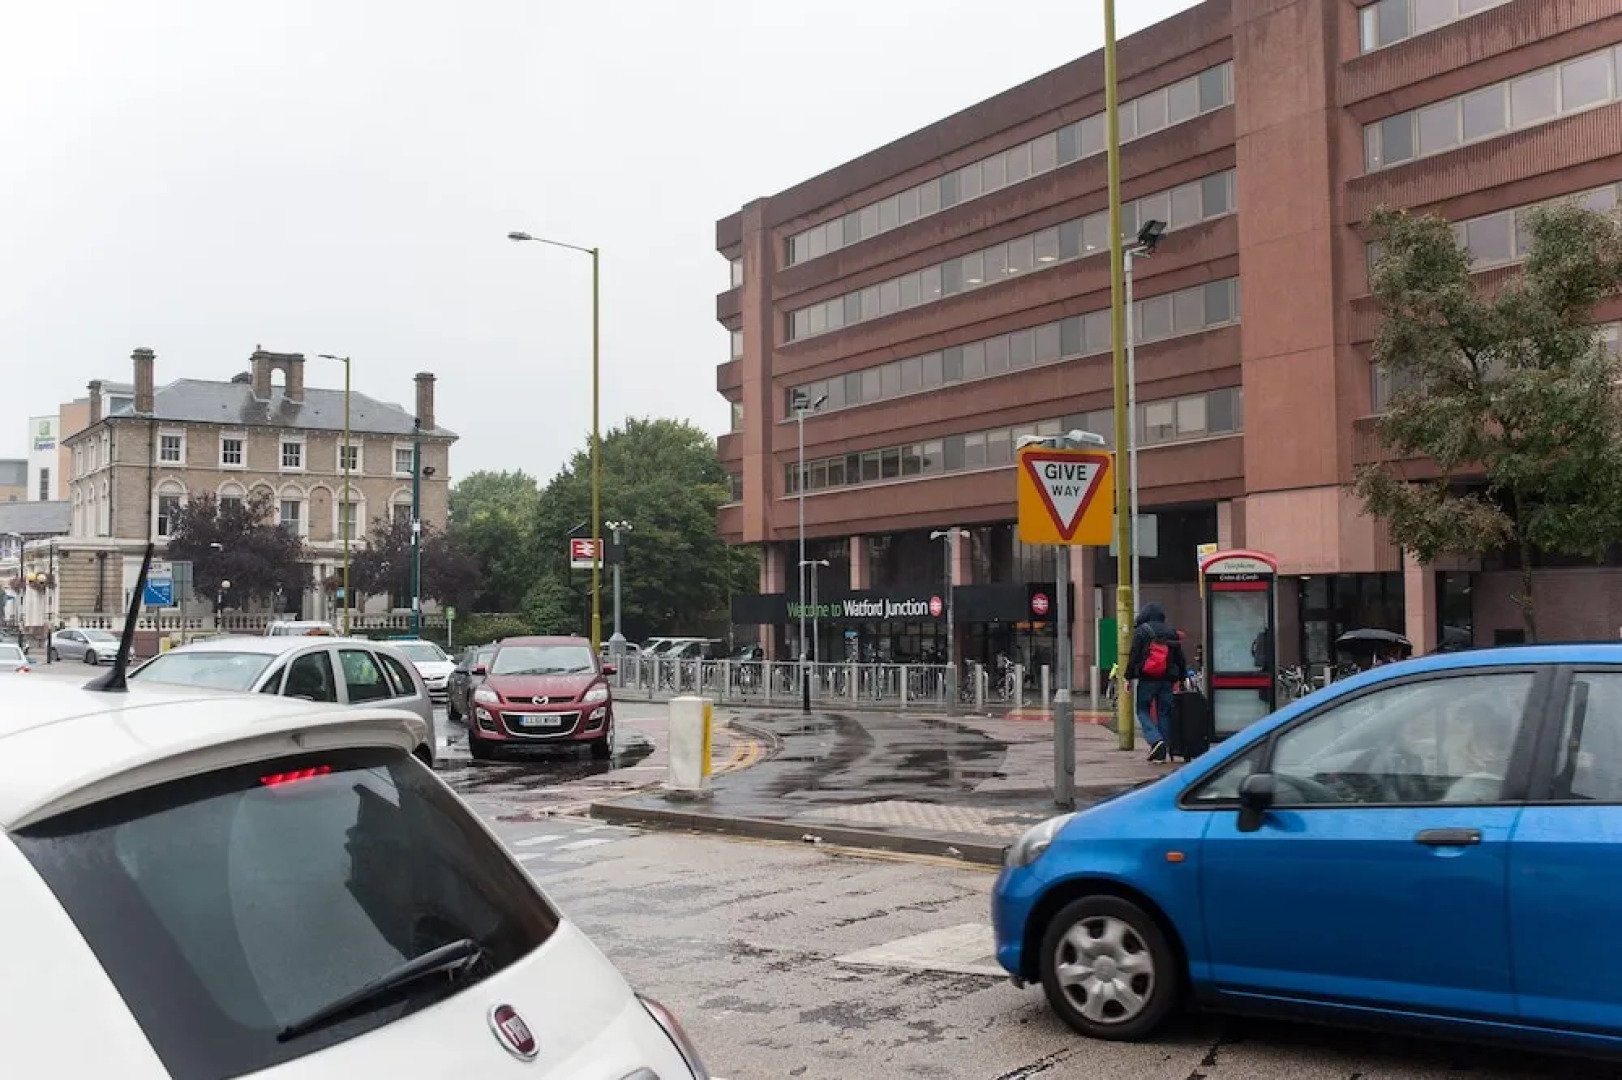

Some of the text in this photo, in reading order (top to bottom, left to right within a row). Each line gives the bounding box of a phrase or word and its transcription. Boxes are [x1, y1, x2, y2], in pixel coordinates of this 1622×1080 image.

[1045, 463, 1087, 480] GIVE
[1052, 485, 1080, 497] WAY
[786, 598, 928, 619] Wecome to Watford Junction
